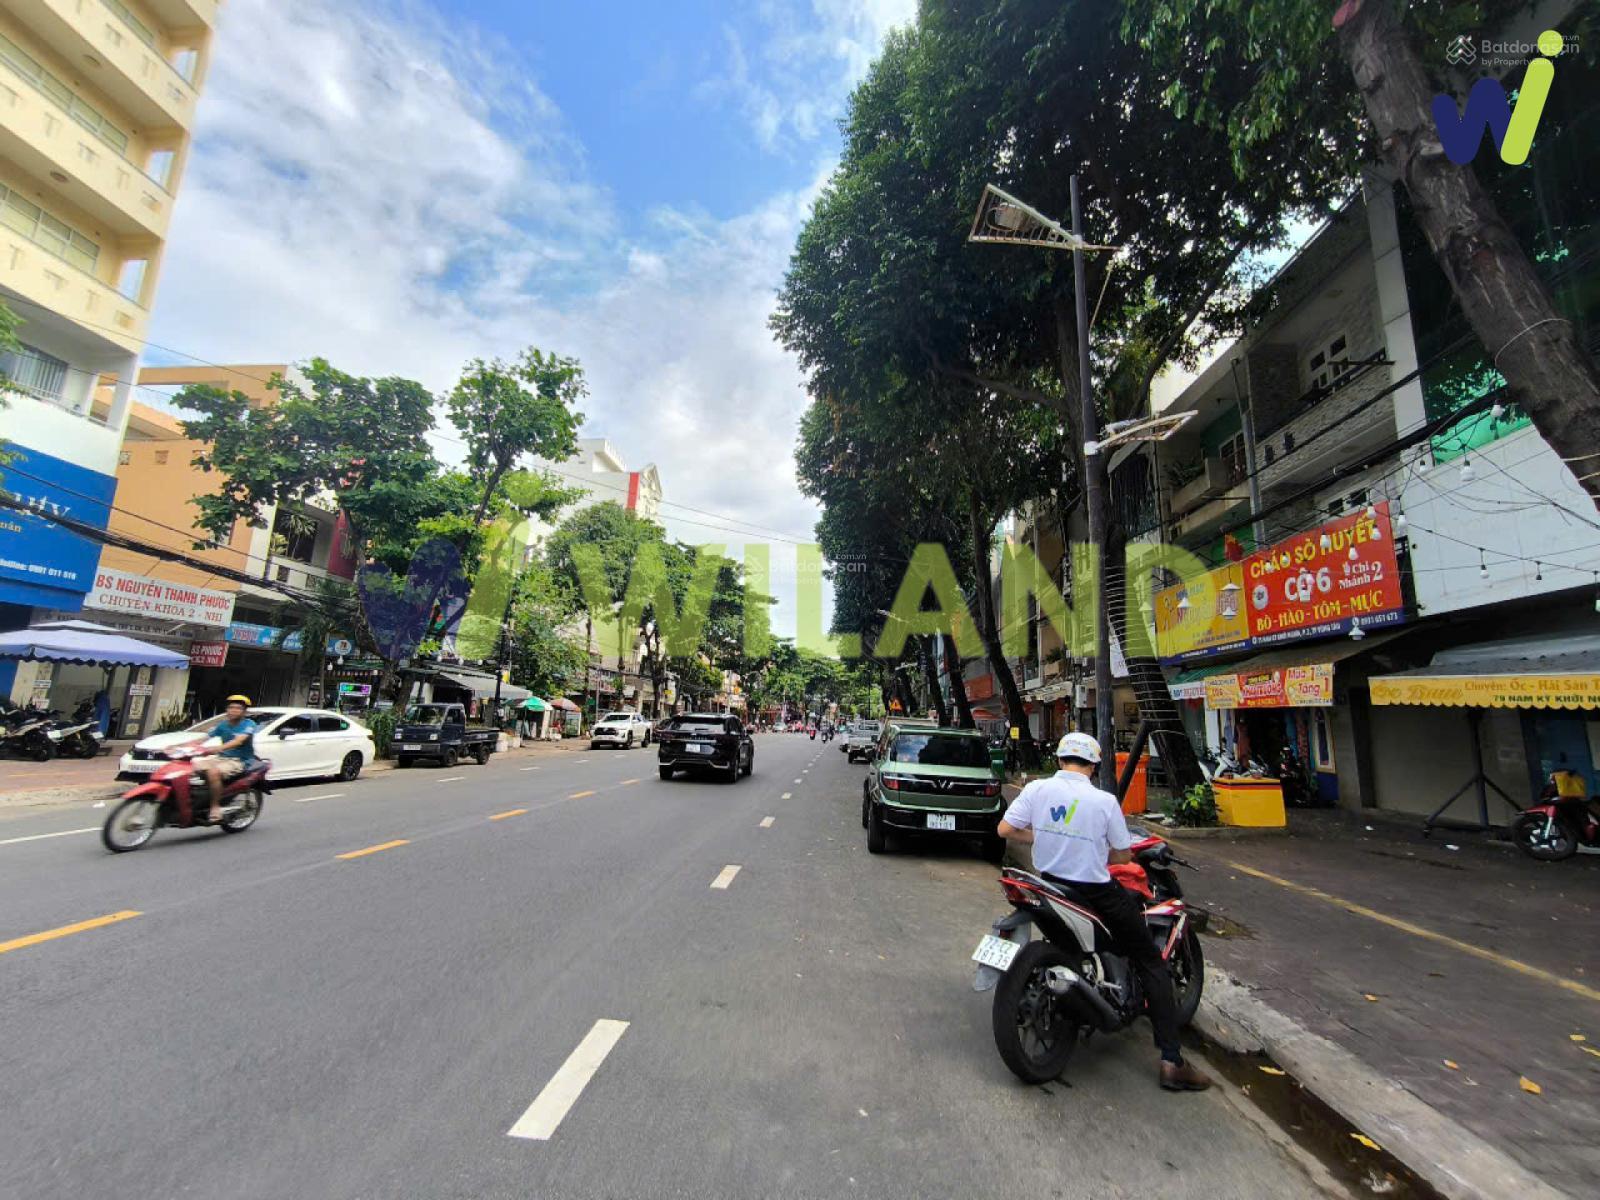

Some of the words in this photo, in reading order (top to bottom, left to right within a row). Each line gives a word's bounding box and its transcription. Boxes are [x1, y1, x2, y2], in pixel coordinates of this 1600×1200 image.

[1295, 538, 1316, 563] SÒ
[1316, 567, 1331, 592] 6
[1371, 561, 1384, 581] 2
[96, 574, 113, 590] BS
[164, 587, 198, 605] THANH
[155, 603, 185, 617] KHOA
